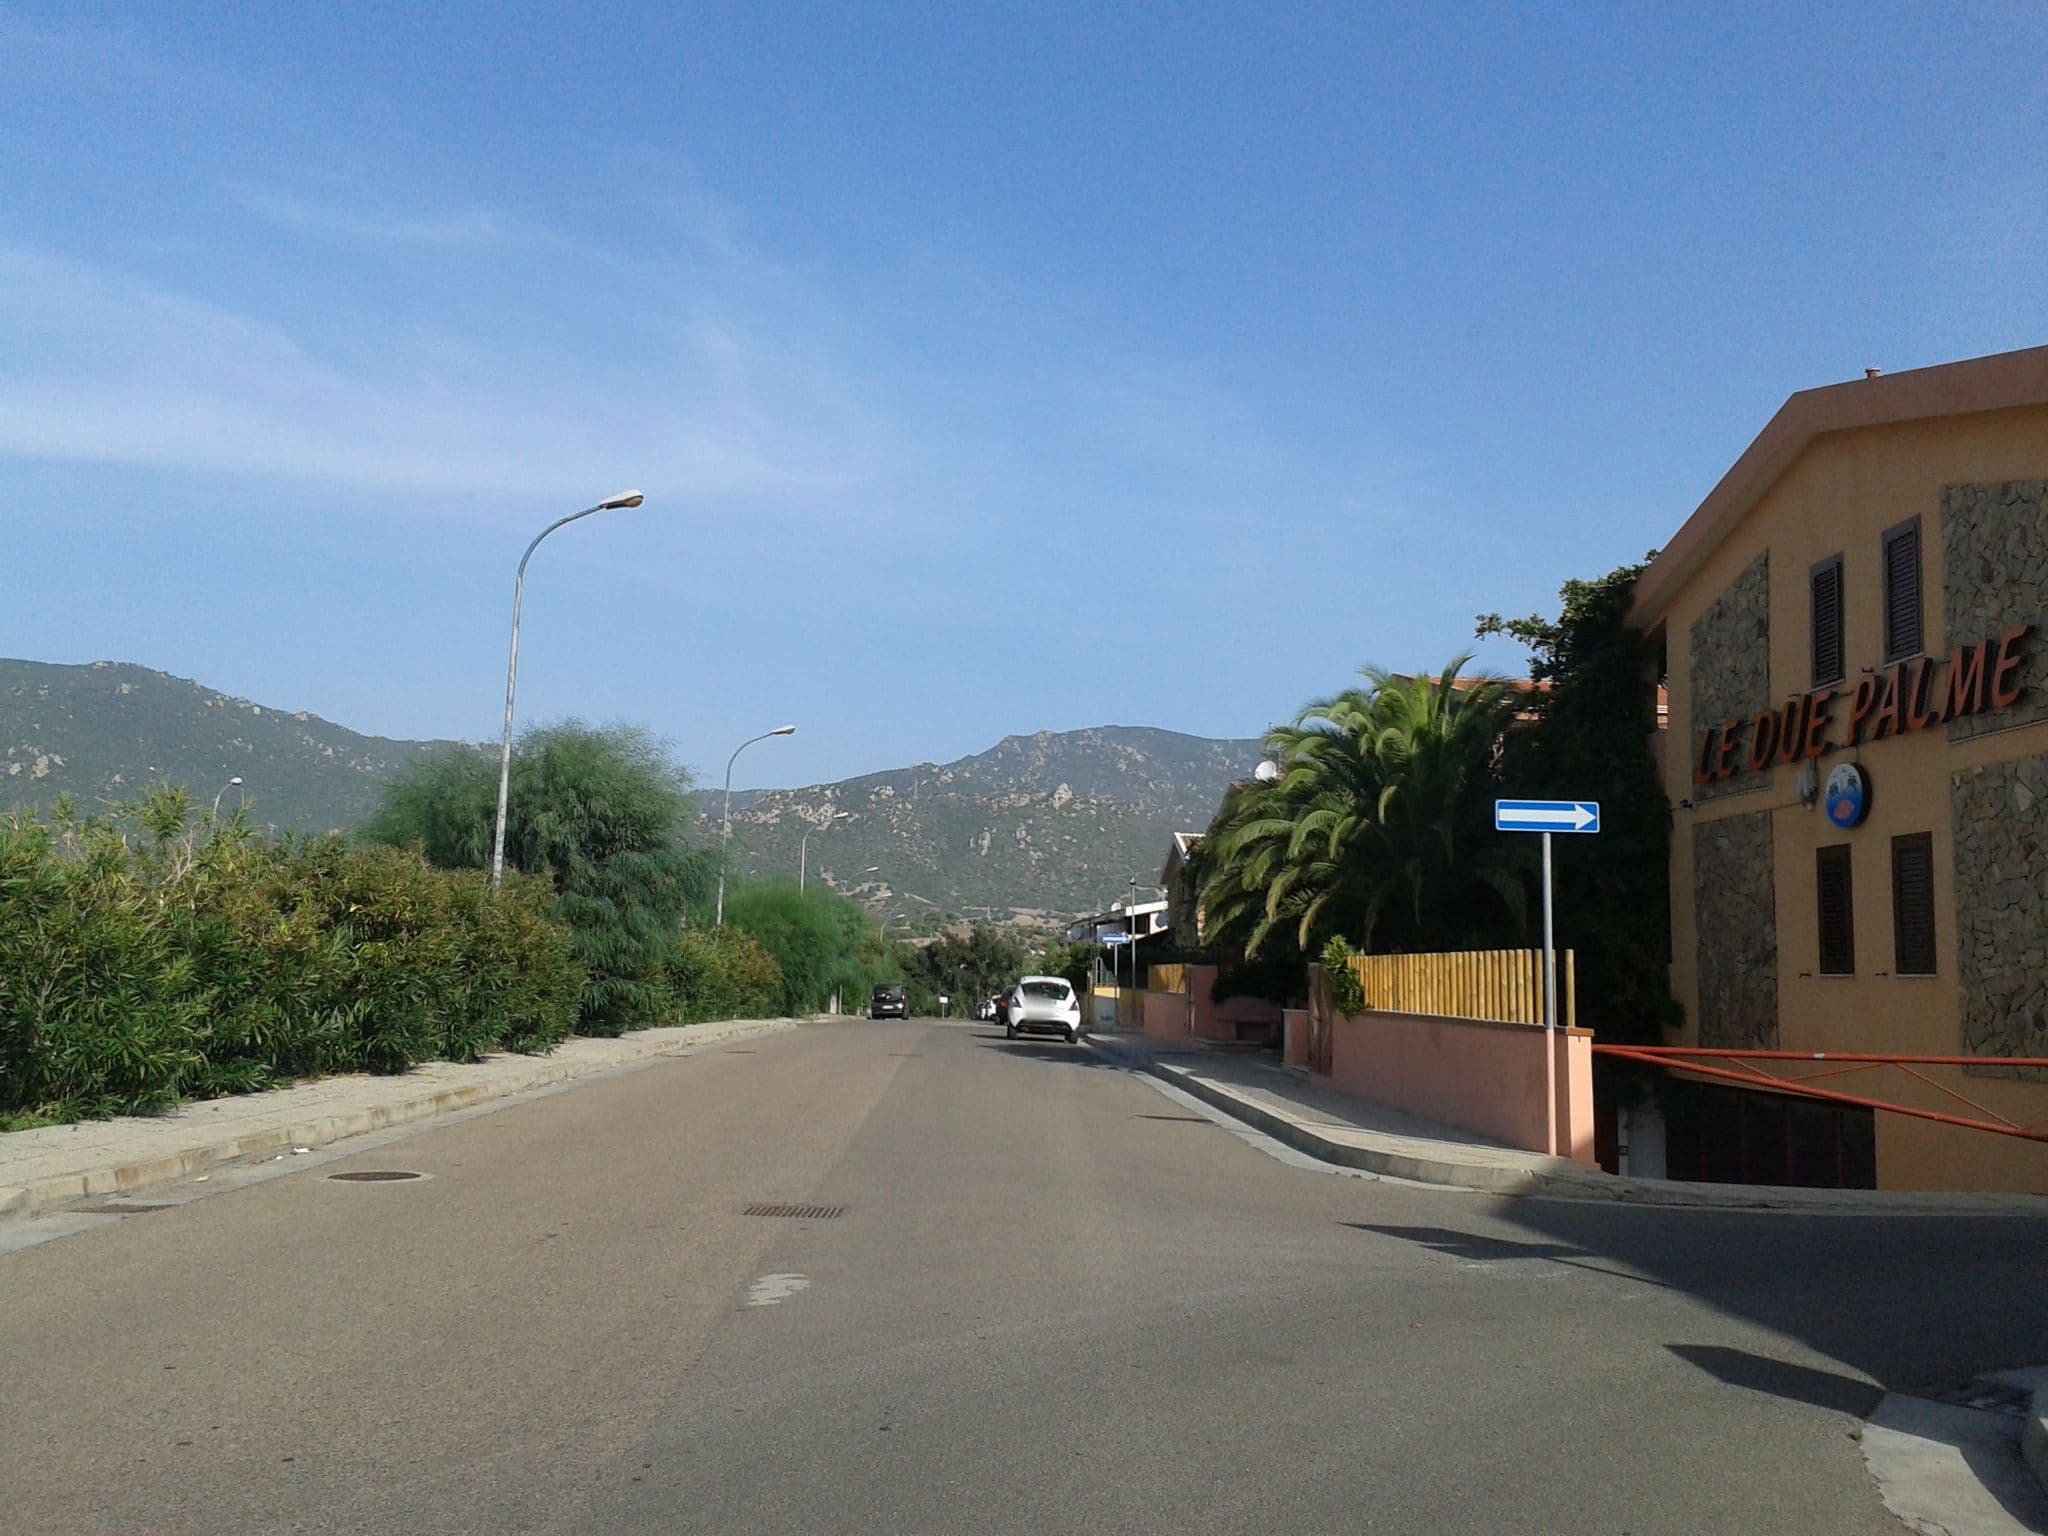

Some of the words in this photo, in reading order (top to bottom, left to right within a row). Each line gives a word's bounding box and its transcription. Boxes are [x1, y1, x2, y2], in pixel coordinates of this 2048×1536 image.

[1695, 720, 1740, 784] LE
[1749, 691, 1834, 770] DUE
[1847, 625, 2033, 746] PALME
